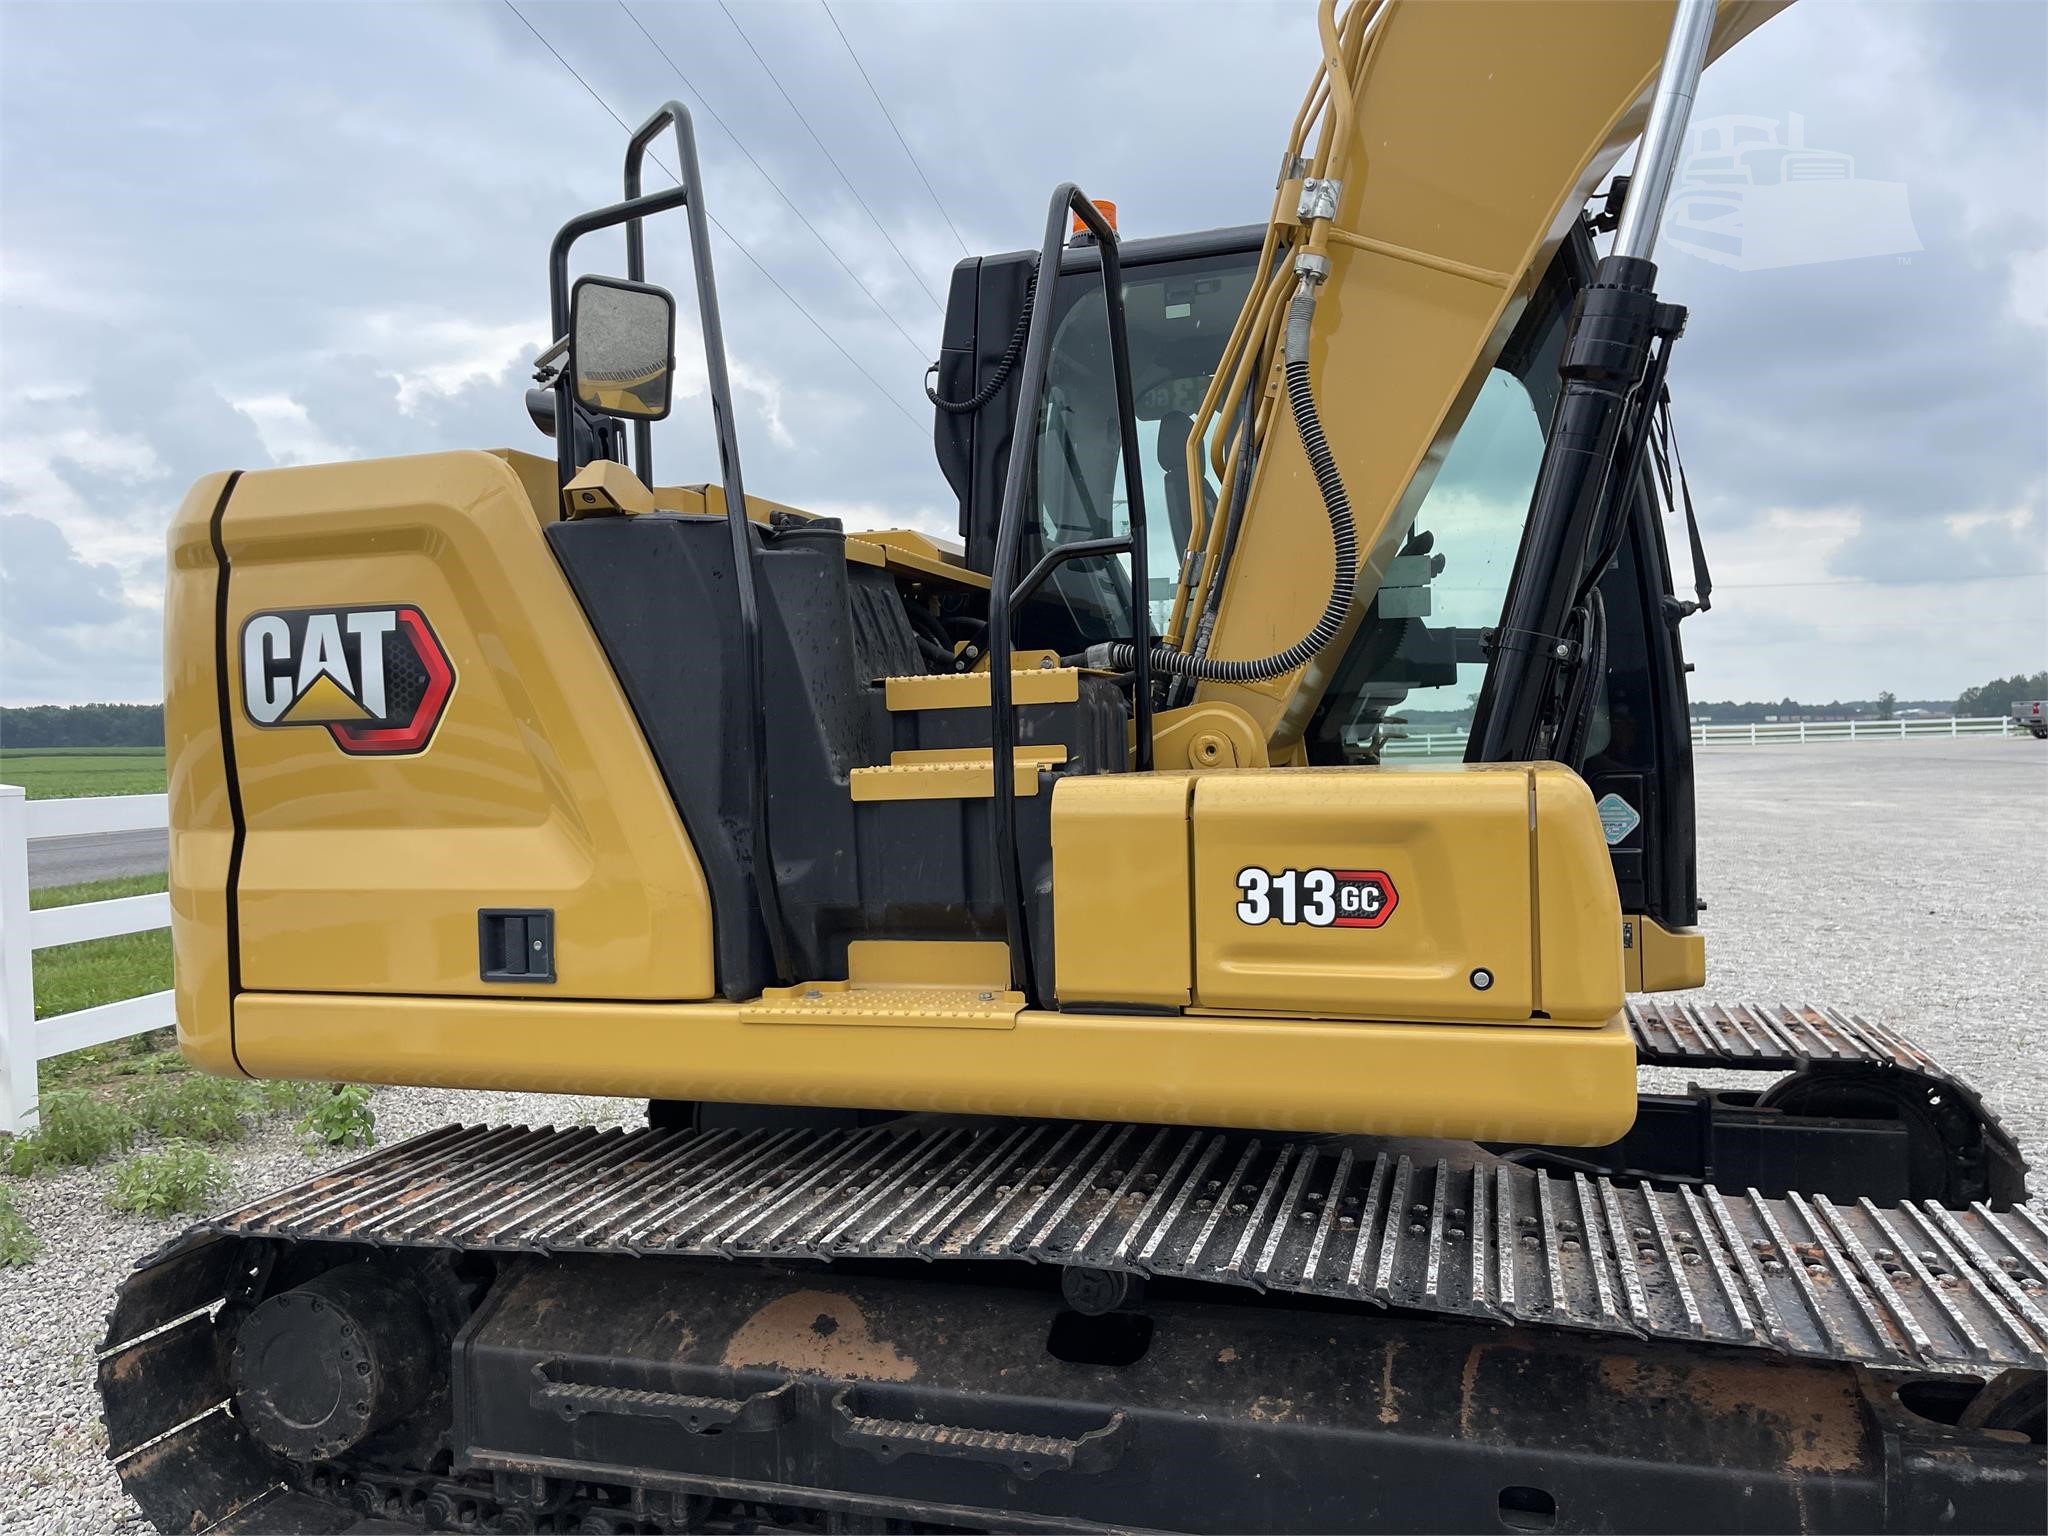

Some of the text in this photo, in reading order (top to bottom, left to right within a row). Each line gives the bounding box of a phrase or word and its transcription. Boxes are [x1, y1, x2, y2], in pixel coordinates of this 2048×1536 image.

[245, 610, 397, 723] CAT
[1237, 868, 1380, 926] 313 GC
